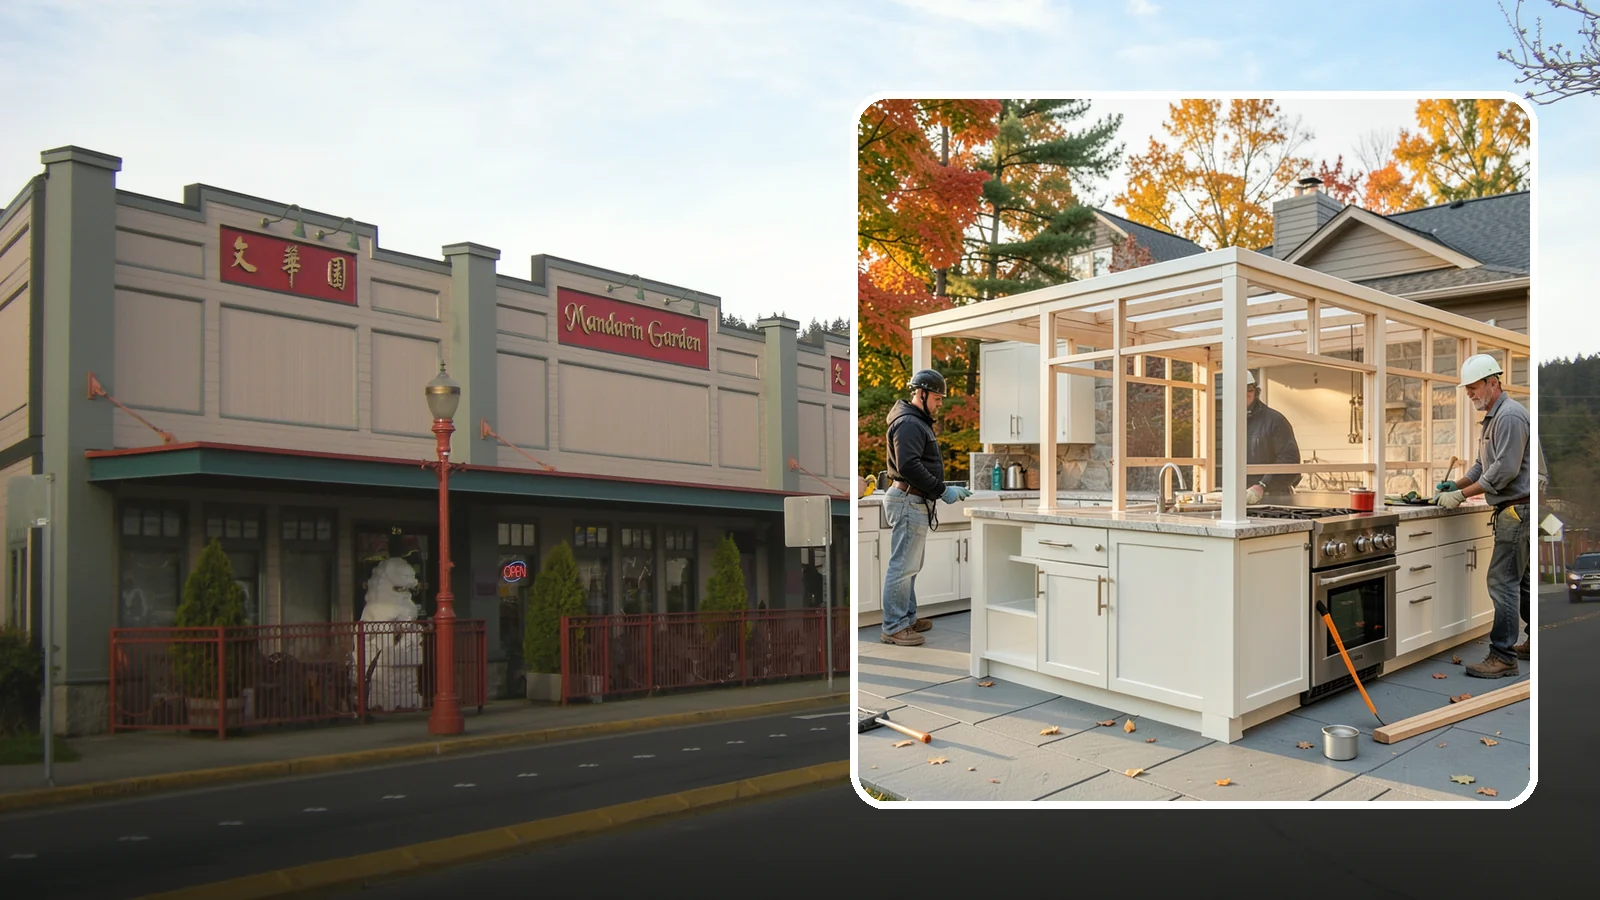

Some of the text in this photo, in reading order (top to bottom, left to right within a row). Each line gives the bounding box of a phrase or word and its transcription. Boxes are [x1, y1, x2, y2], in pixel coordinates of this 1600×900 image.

[231, 235, 346, 291] 文華園
[564, 302, 702, 352] Mandarin Garden
[503, 565, 527, 578] OPEN
